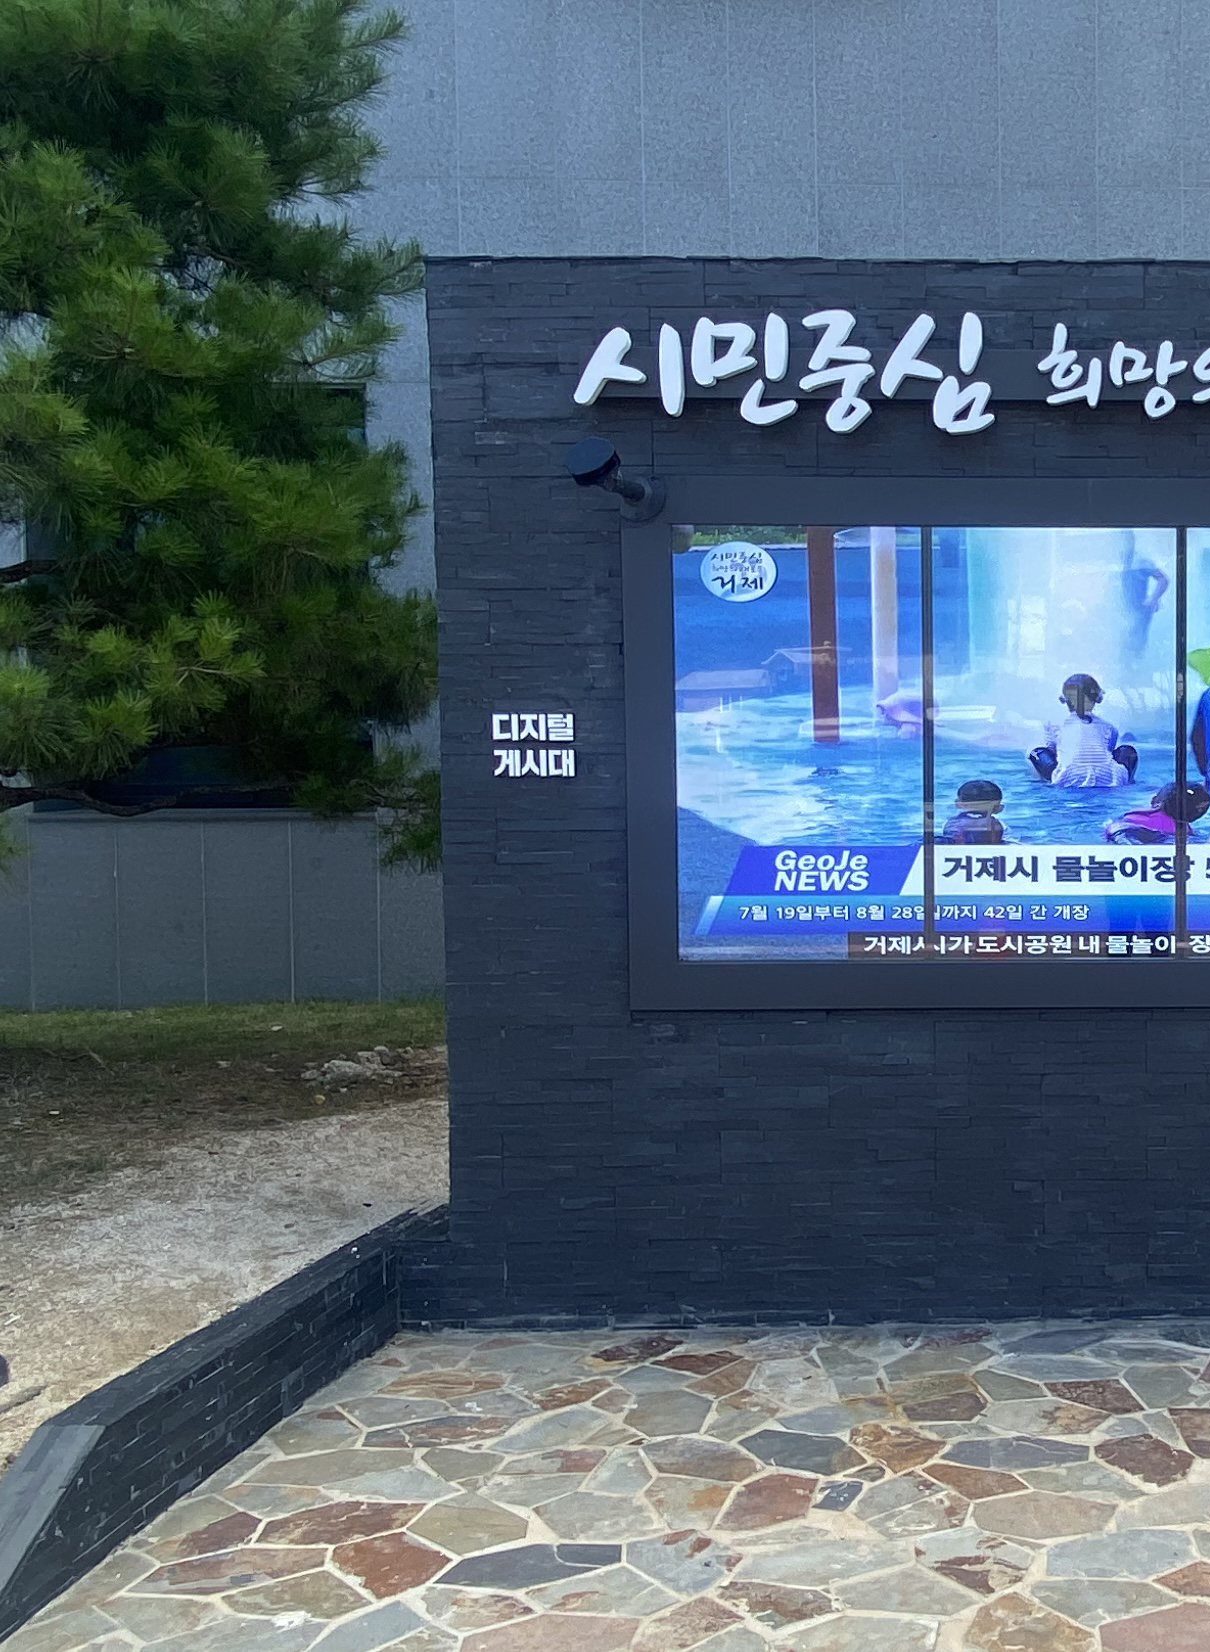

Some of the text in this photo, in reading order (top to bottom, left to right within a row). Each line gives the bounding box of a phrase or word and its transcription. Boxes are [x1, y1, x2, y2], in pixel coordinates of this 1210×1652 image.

[573, 309, 997, 435] 시민중심
[711, 575, 764, 594] 거제
[492, 713, 574, 741] 디지털
[493, 749, 576, 777] 게시대
[774, 850, 868, 871] GeoJe
[942, 855, 1039, 883] 거제시
[1052, 855, 1195, 883] 물놀이장
[774, 871, 869, 892] NEWS
[739, 905, 1090, 921] 7월 19일부터 8월 28일까지 42일 간 개장
[863, 935, 972, 955] 거제시가
[975, 935, 1072, 954] 도시공원
[1078, 935, 1100, 954] 내
